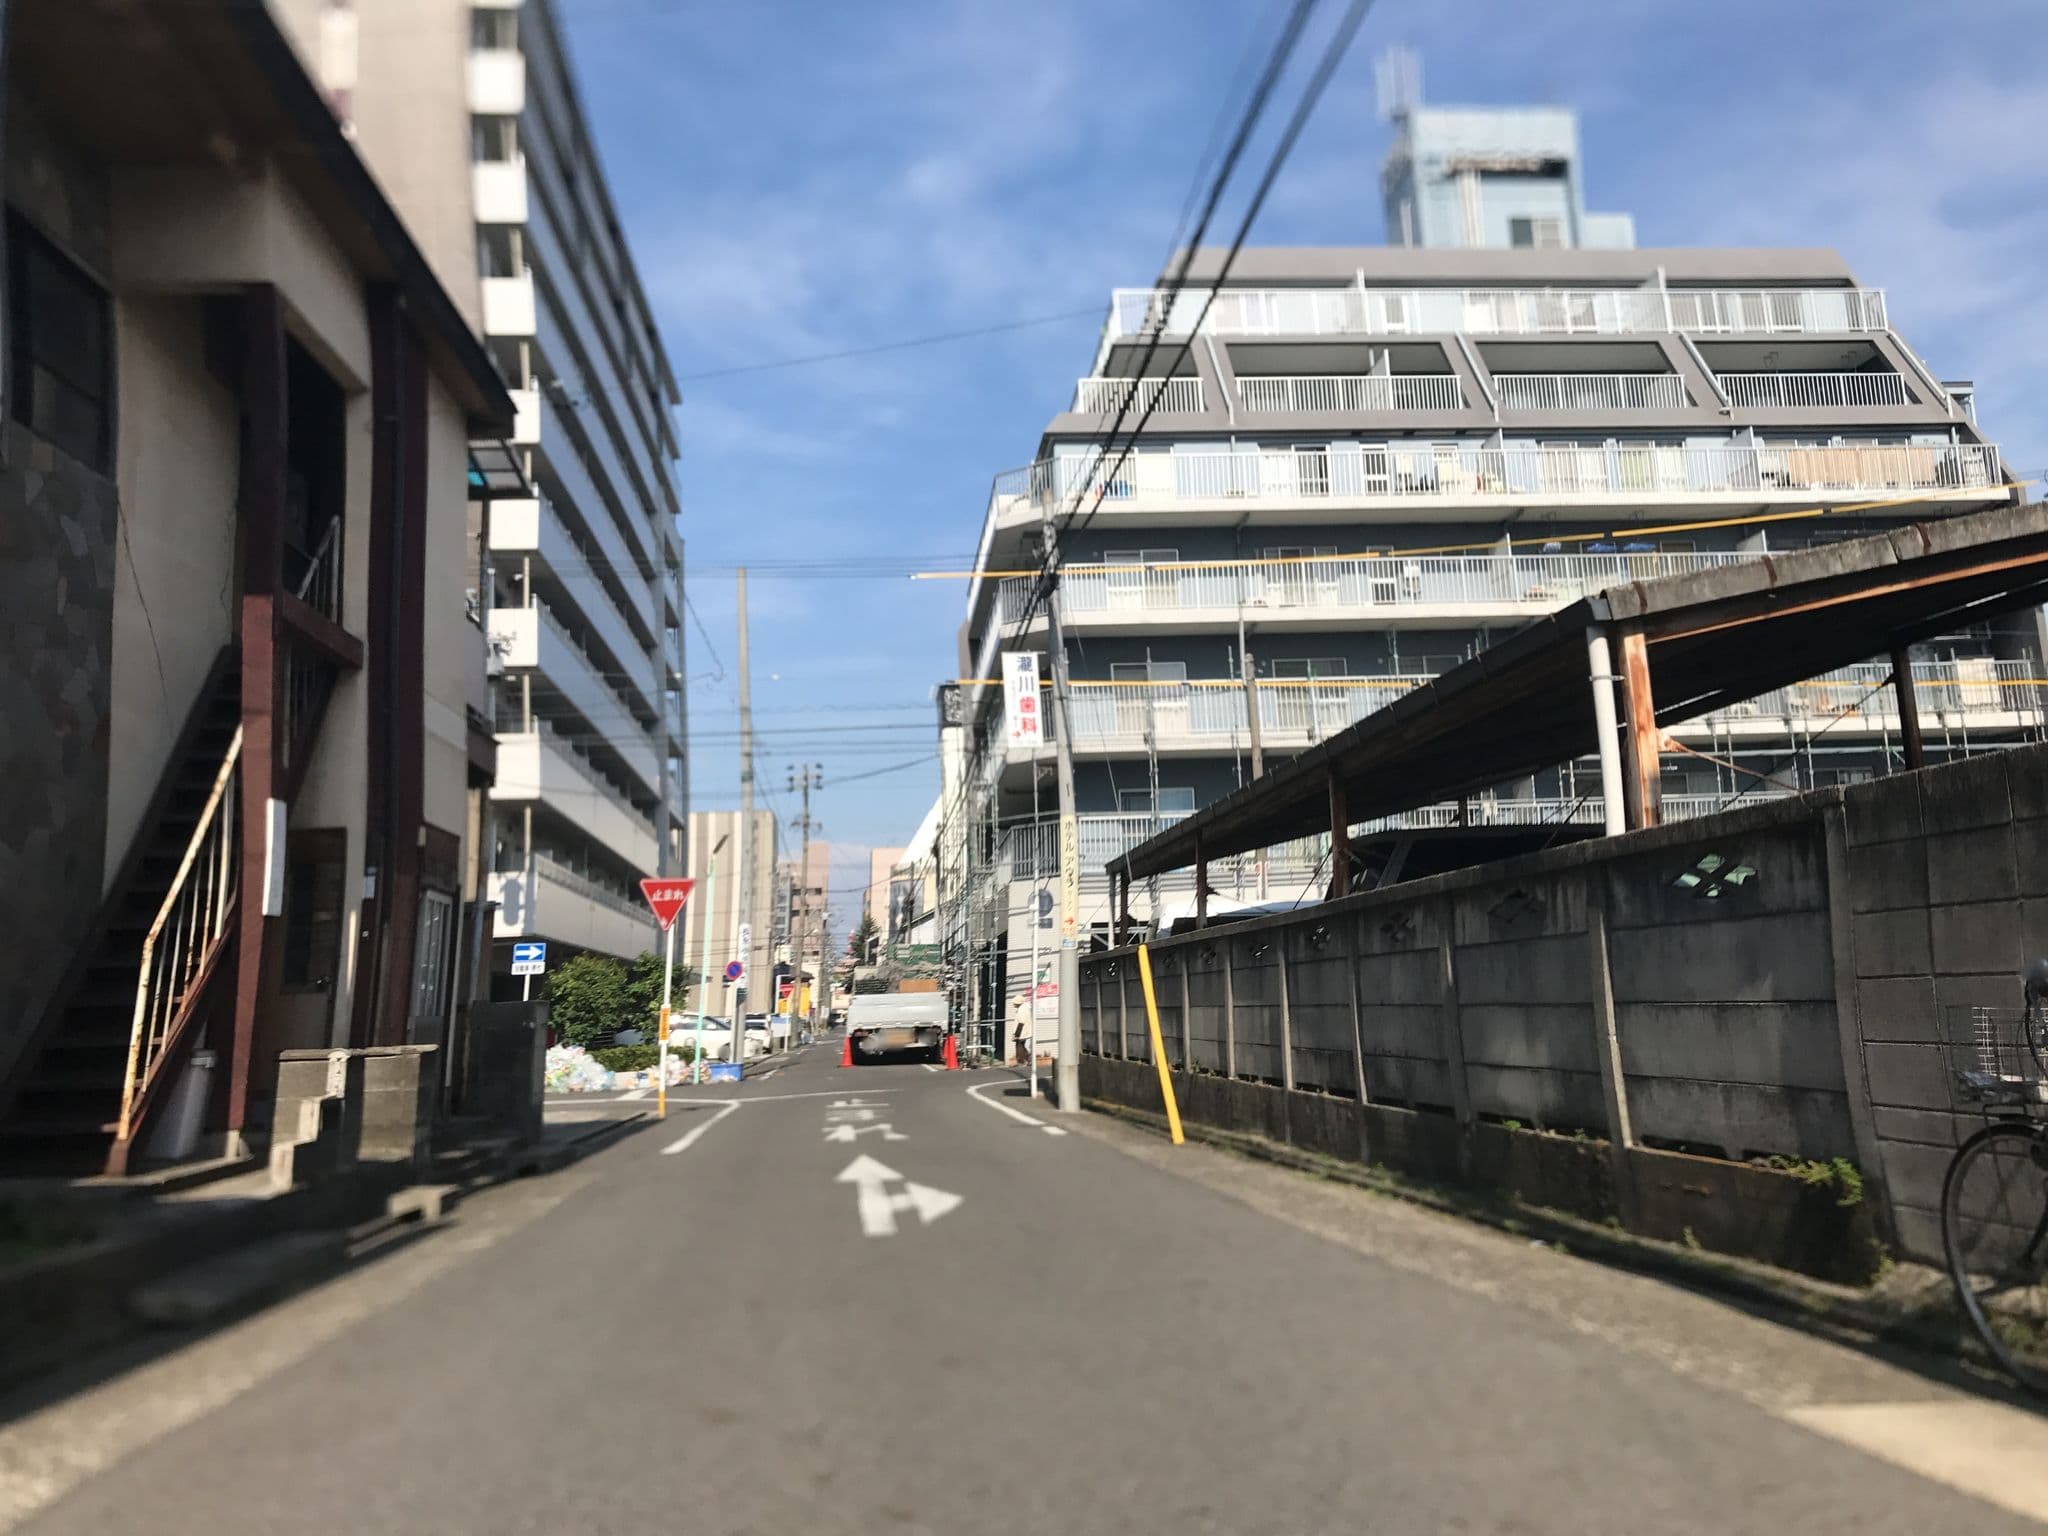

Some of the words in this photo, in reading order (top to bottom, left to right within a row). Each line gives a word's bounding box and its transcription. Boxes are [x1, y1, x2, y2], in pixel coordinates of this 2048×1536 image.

[1016, 655, 1037, 734] 瀧川歯科
[652, 888, 684, 902] 止まれ
